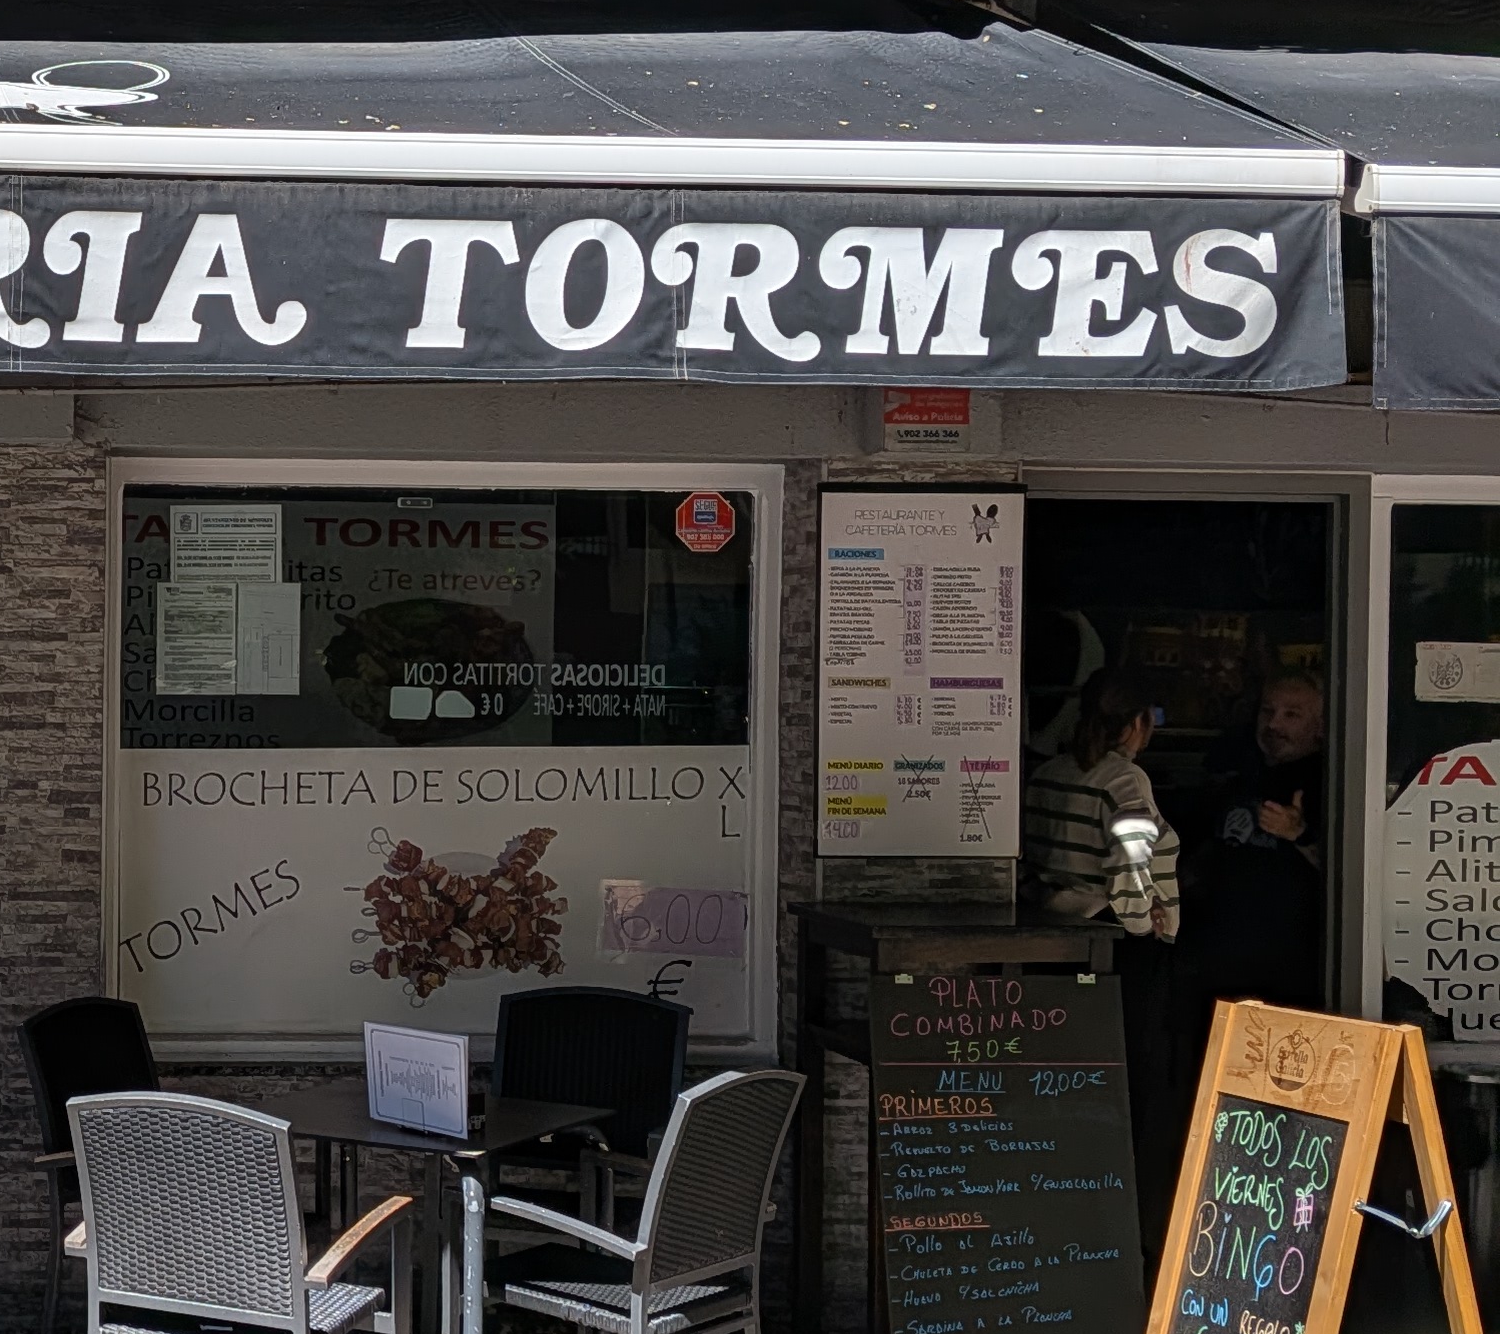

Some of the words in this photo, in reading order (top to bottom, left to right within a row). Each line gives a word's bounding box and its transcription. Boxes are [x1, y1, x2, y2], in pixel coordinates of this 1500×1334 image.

[378, 217, 1279, 361] TORMES
[892, 412, 920, 421] Aviso
[904, 429, 921, 438] 902
[923, 429, 940, 438] 366
[942, 429, 960, 438] 366
[855, 509, 934, 521] RESTAURANTE
[303, 518, 549, 550] TORMES
[845, 523, 905, 536] CAFETERÍA
[910, 525, 957, 536] TORMES
[834, 550, 877, 558] RACIONES
[368, 568, 413, 592] ¿Te
[423, 569, 542, 592] atreves?
[831, 679, 887, 687] SANDWICHES
[124, 699, 256, 722] Morcilla
[827, 761, 852, 769] MENÚ
[854, 762, 884, 770] DIARIO
[142, 770, 375, 806] BROCHETA
[392, 769, 443, 804] DE
[457, 766, 704, 804] SOLOMILLO
[827, 796, 852, 805] MENÚ
[827, 807, 840, 815] FIN
[841, 807, 851, 815] DE
[853, 807, 886, 815] SEMANA
[118, 860, 302, 974] TORMES
[929, 976, 1023, 1009] PLATO
[890, 1008, 1067, 1037] COMBINADO
[937, 1070, 1003, 1091] MENU
[879, 1088, 994, 1117] PRIMEROS
[1229, 1110, 1287, 1168] TODOS
[1289, 1129, 1333, 1191] LOS
[1214, 1166, 1284, 1231] VIERNES
[889, 1211, 984, 1229] SEGUNDOS
[1189, 1201, 1305, 1302] BINGO
[1181, 1288, 1204, 1317] CON
[1210, 1297, 1229, 1327] UN
